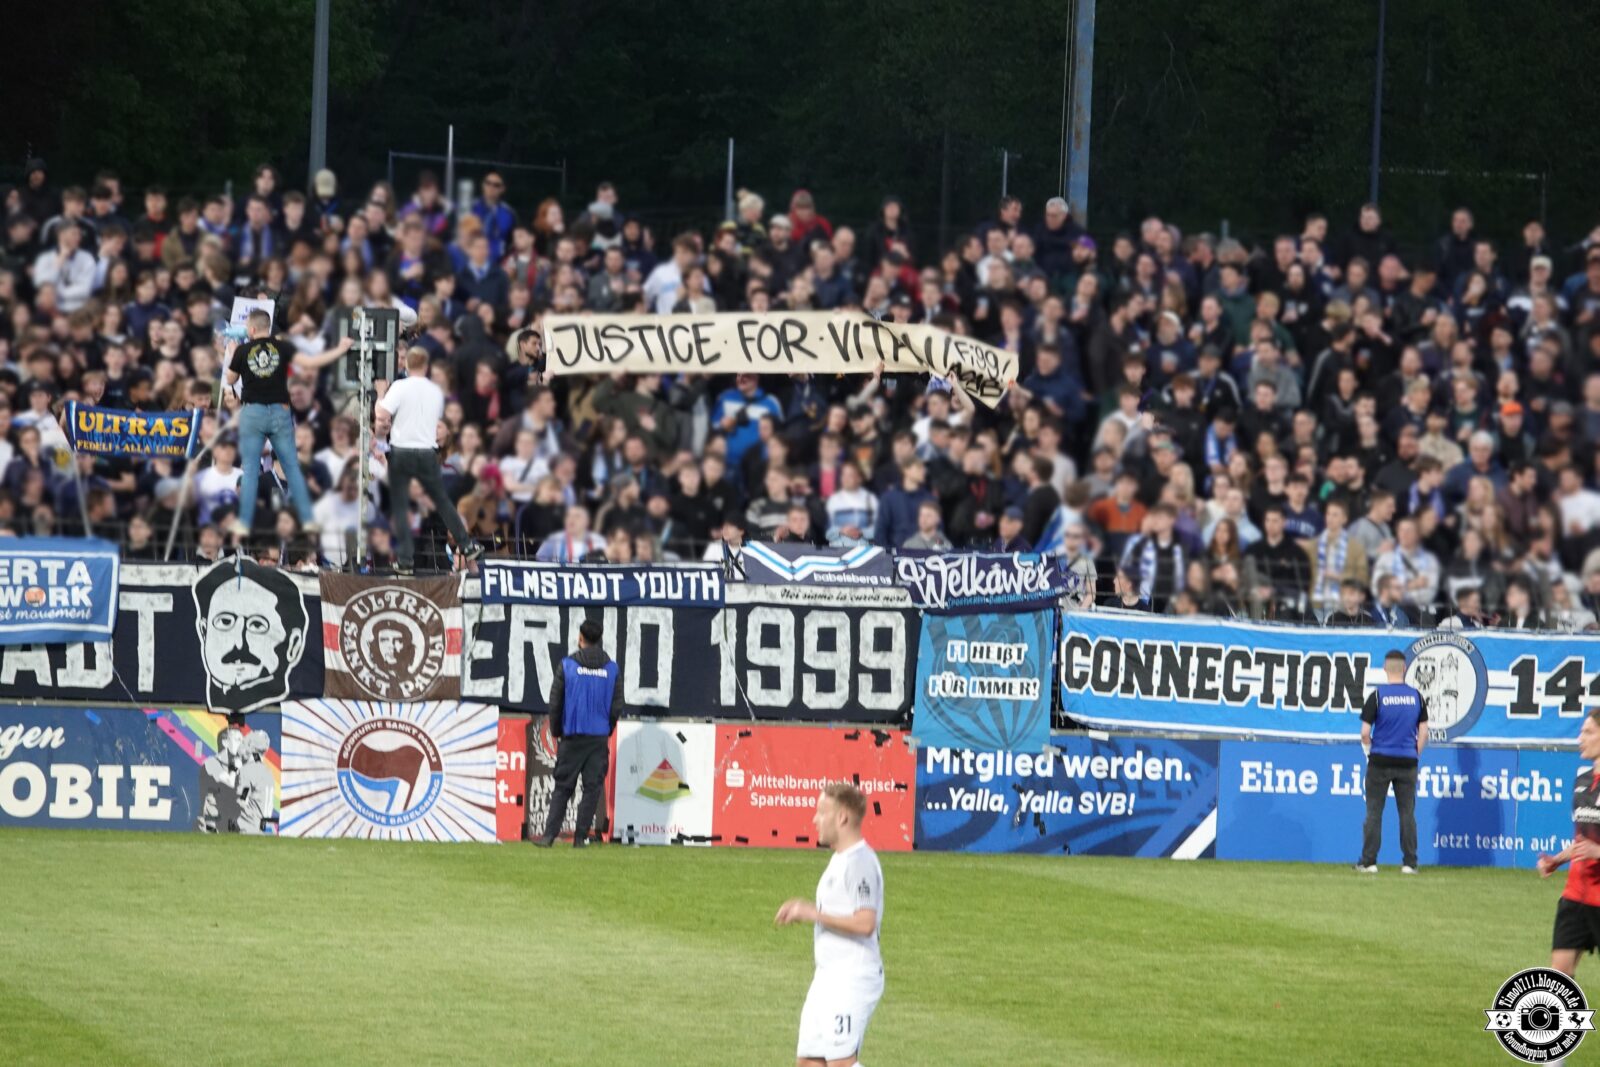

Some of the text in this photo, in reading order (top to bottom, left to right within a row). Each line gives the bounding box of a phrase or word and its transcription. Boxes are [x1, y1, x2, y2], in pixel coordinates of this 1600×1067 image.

[552, 323, 721, 367] JUSTICE
[737, 319, 818, 363] FOR
[78, 411, 190, 437] ULTRAS
[77, 439, 113, 453] FEDELI
[123, 444, 151, 454] ALLA
[483, 568, 721, 601] FILMSTADT YOUTH
[813, 572, 879, 586] babelsberg
[343, 619, 445, 698] SANKT PAULI
[710, 606, 907, 710] 1999
[1061, 632, 1371, 712] CONNECTION
[928, 671, 1041, 701] FÜR IMMER!
[1382, 695, 1416, 706] ORDNER
[925, 746, 1192, 783] Mitglied werden.
[1239, 760, 1319, 796] Eine
[1416, 765, 1469, 798] für
[1480, 768, 1563, 802] sich:
[750, 792, 816, 809] Sparkasse
[1019, 789, 1073, 814] Yalla
[1078, 792, 1136, 816] SVB!
[640, 822, 685, 835] mbs.de
[1433, 831, 1470, 849] Jetzt
[1475, 833, 1524, 850] testen
[1530, 834, 1557, 852] auf
[834, 1013, 852, 1035] 31
